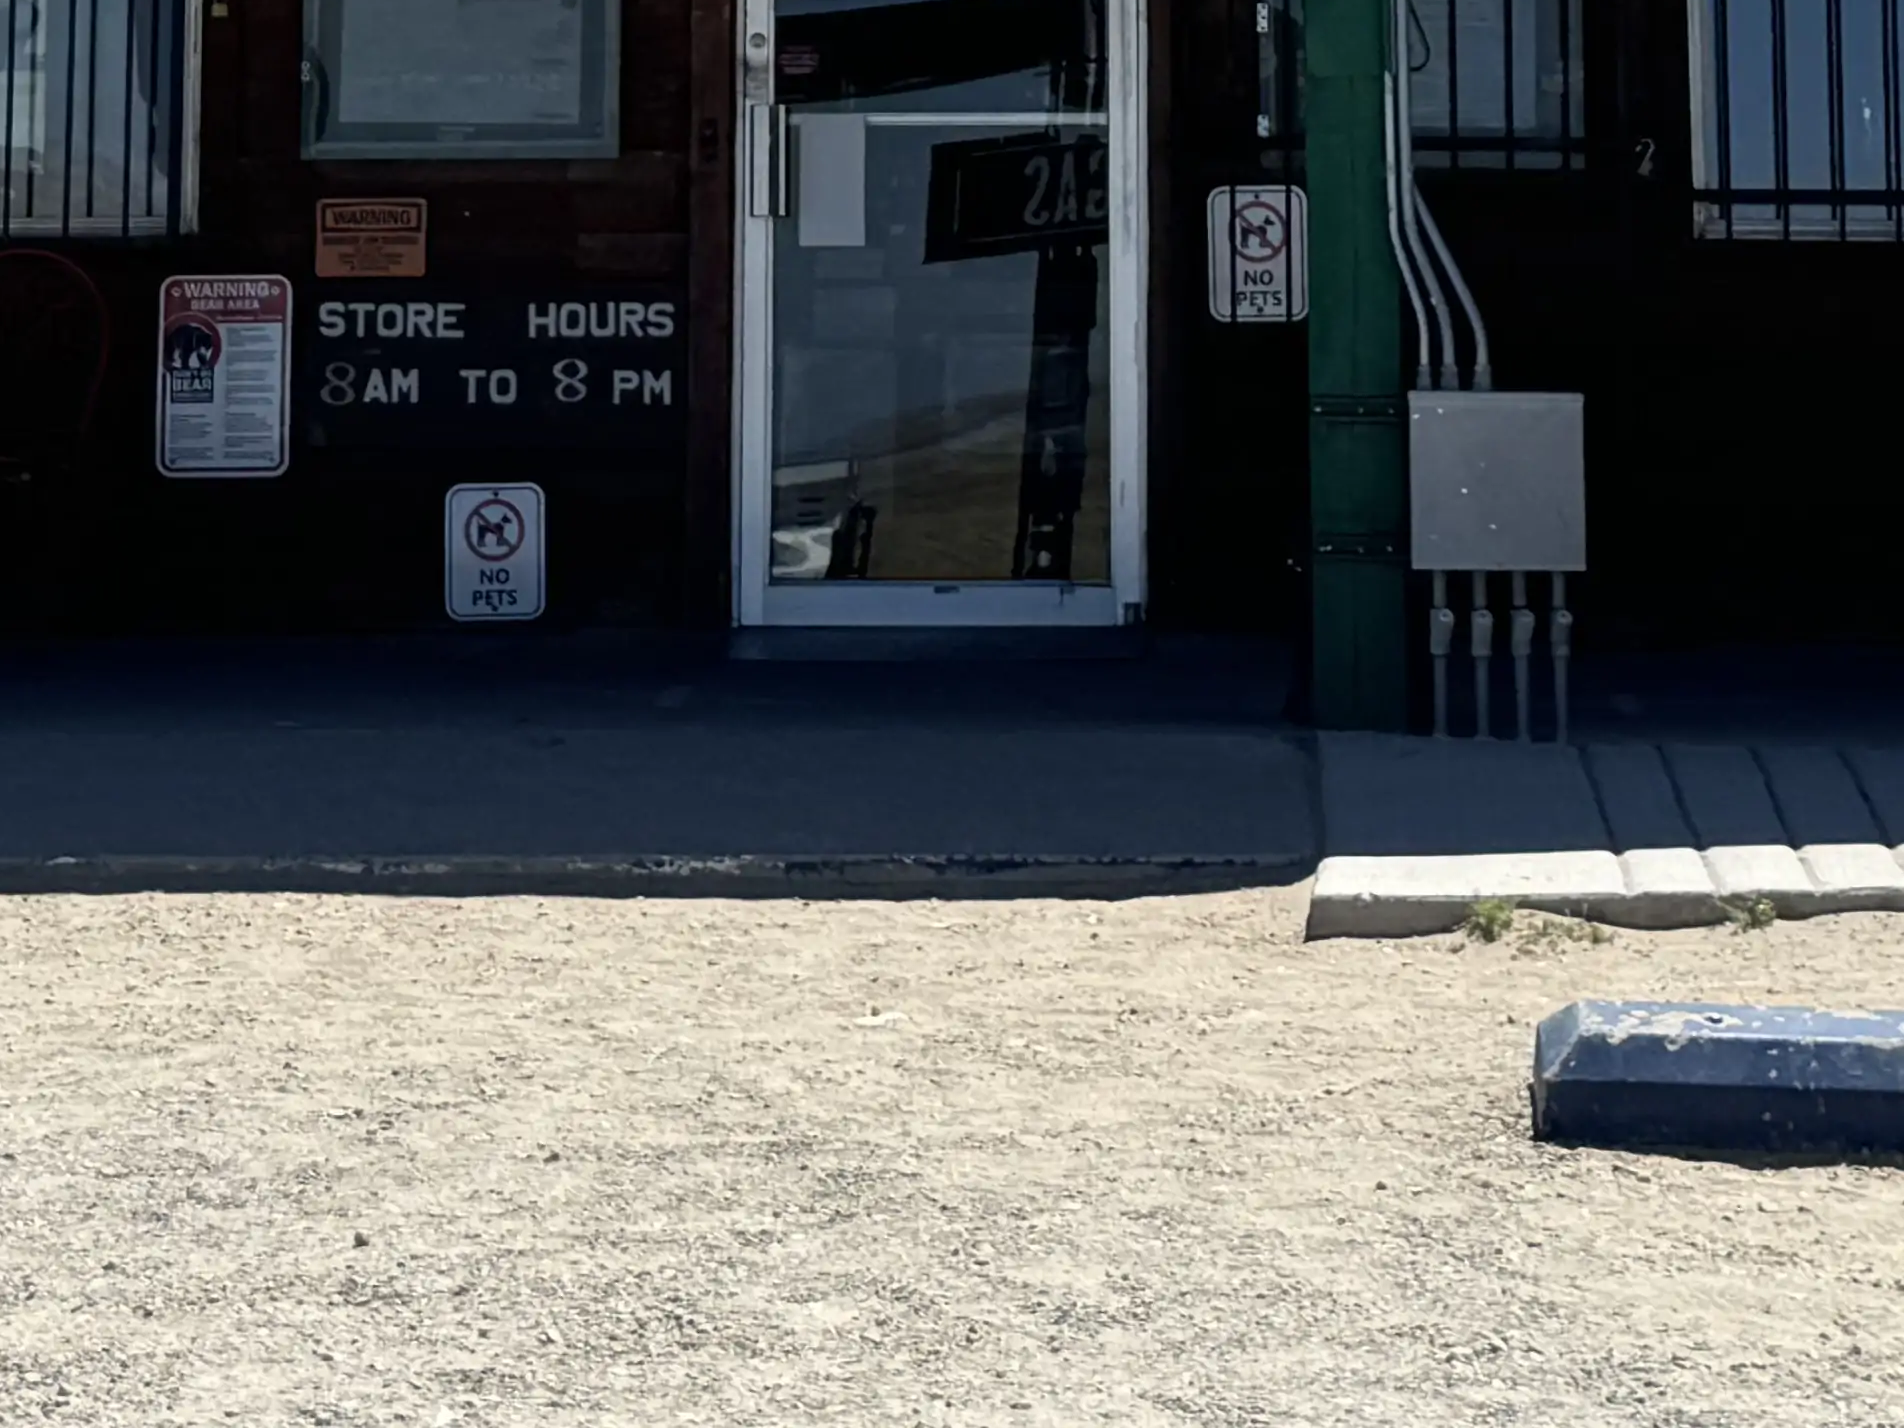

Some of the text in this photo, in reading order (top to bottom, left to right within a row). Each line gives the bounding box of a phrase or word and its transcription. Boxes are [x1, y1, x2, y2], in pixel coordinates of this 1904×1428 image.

[331, 208, 411, 225] WARNING
[1244, 270, 1274, 287] NO
[183, 281, 269, 298] WARNING
[227, 298, 261, 310] AREA
[1234, 290, 1283, 308] PETS
[319, 302, 675, 338] STORE HOURS
[460, 369, 517, 404] TO
[552, 358, 588, 402] 8
[613, 369, 672, 405] PM
[480, 568, 510, 585] NO
[472, 589, 517, 607] PETS
